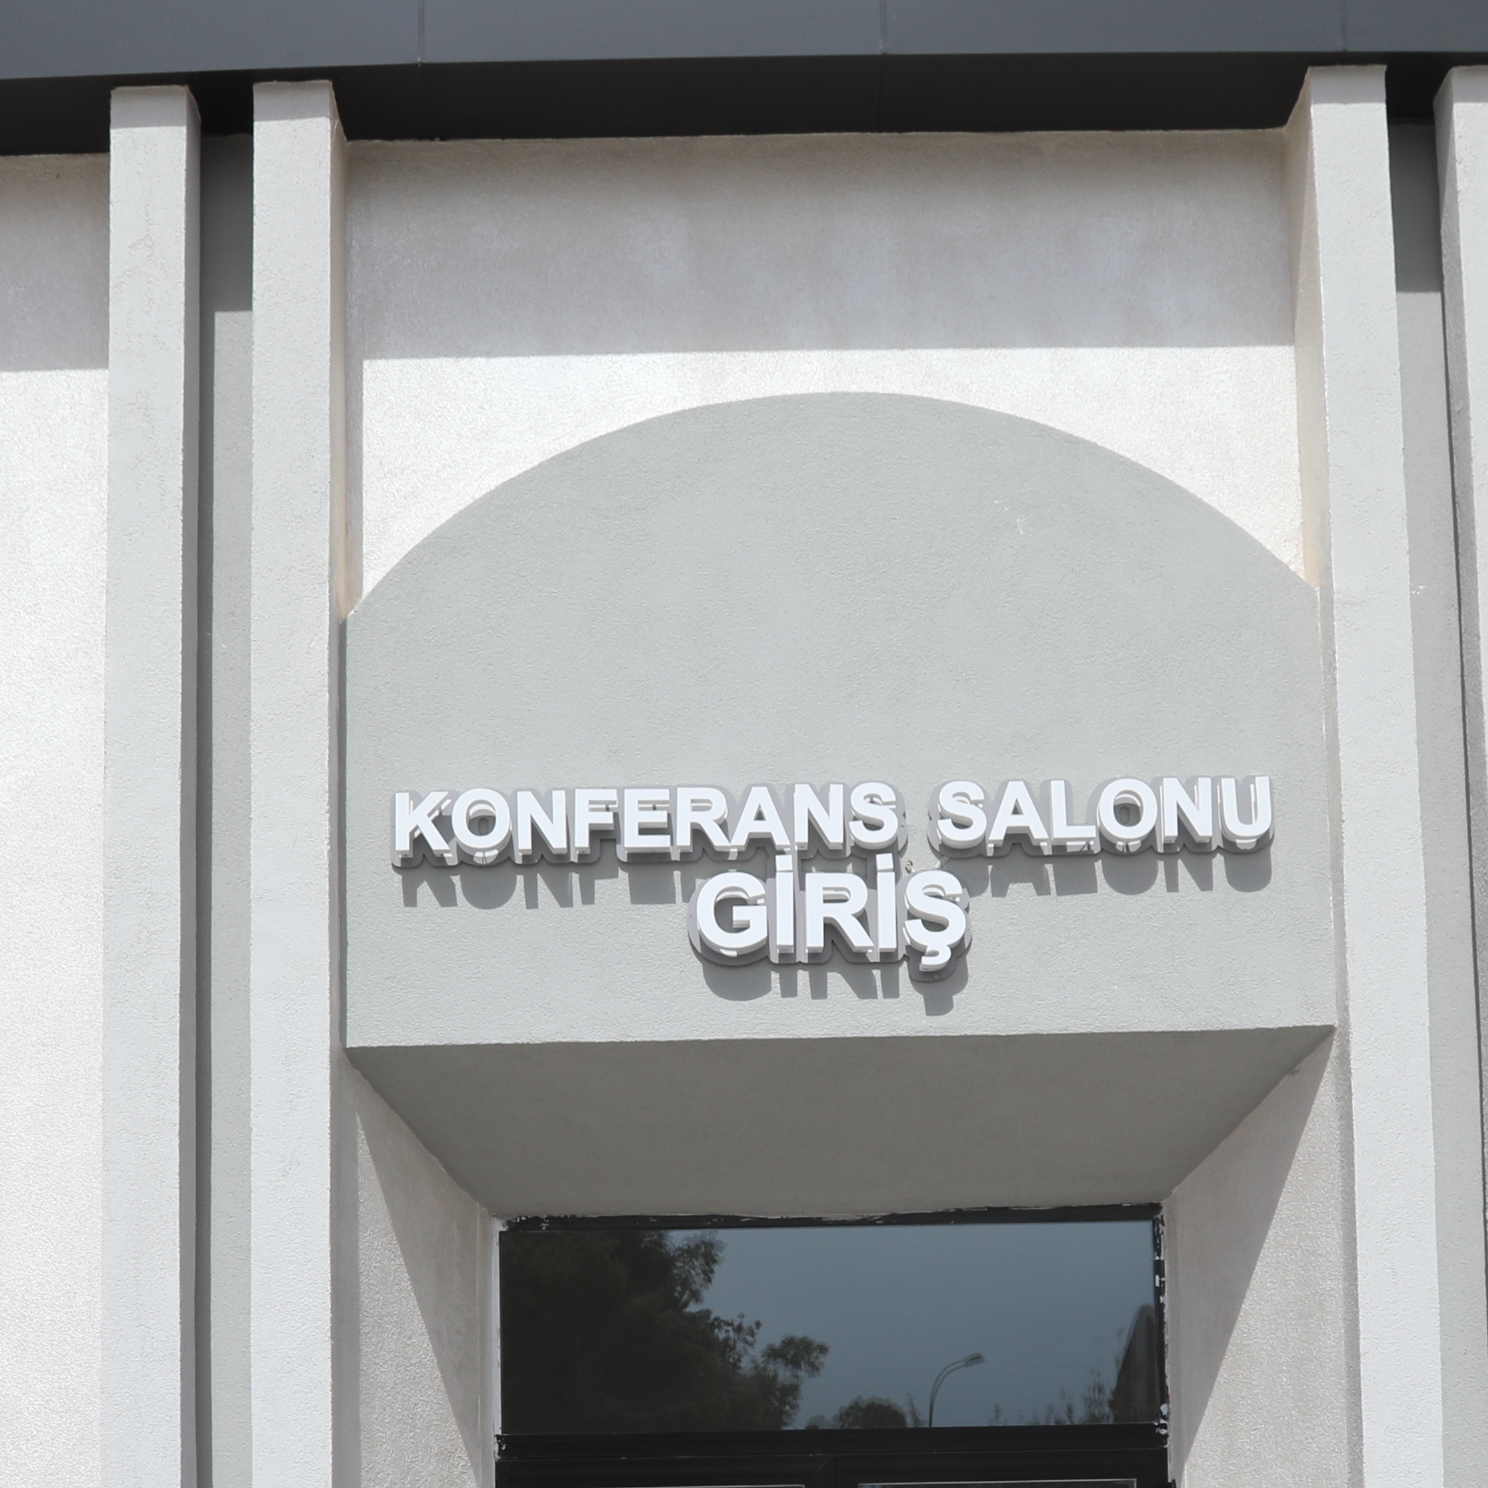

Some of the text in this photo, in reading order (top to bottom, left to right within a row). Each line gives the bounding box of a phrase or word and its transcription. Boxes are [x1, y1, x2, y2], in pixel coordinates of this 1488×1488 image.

[394, 775, 1273, 857] KONFERANS SALONU
[695, 852, 967, 970] GİRİŞ
